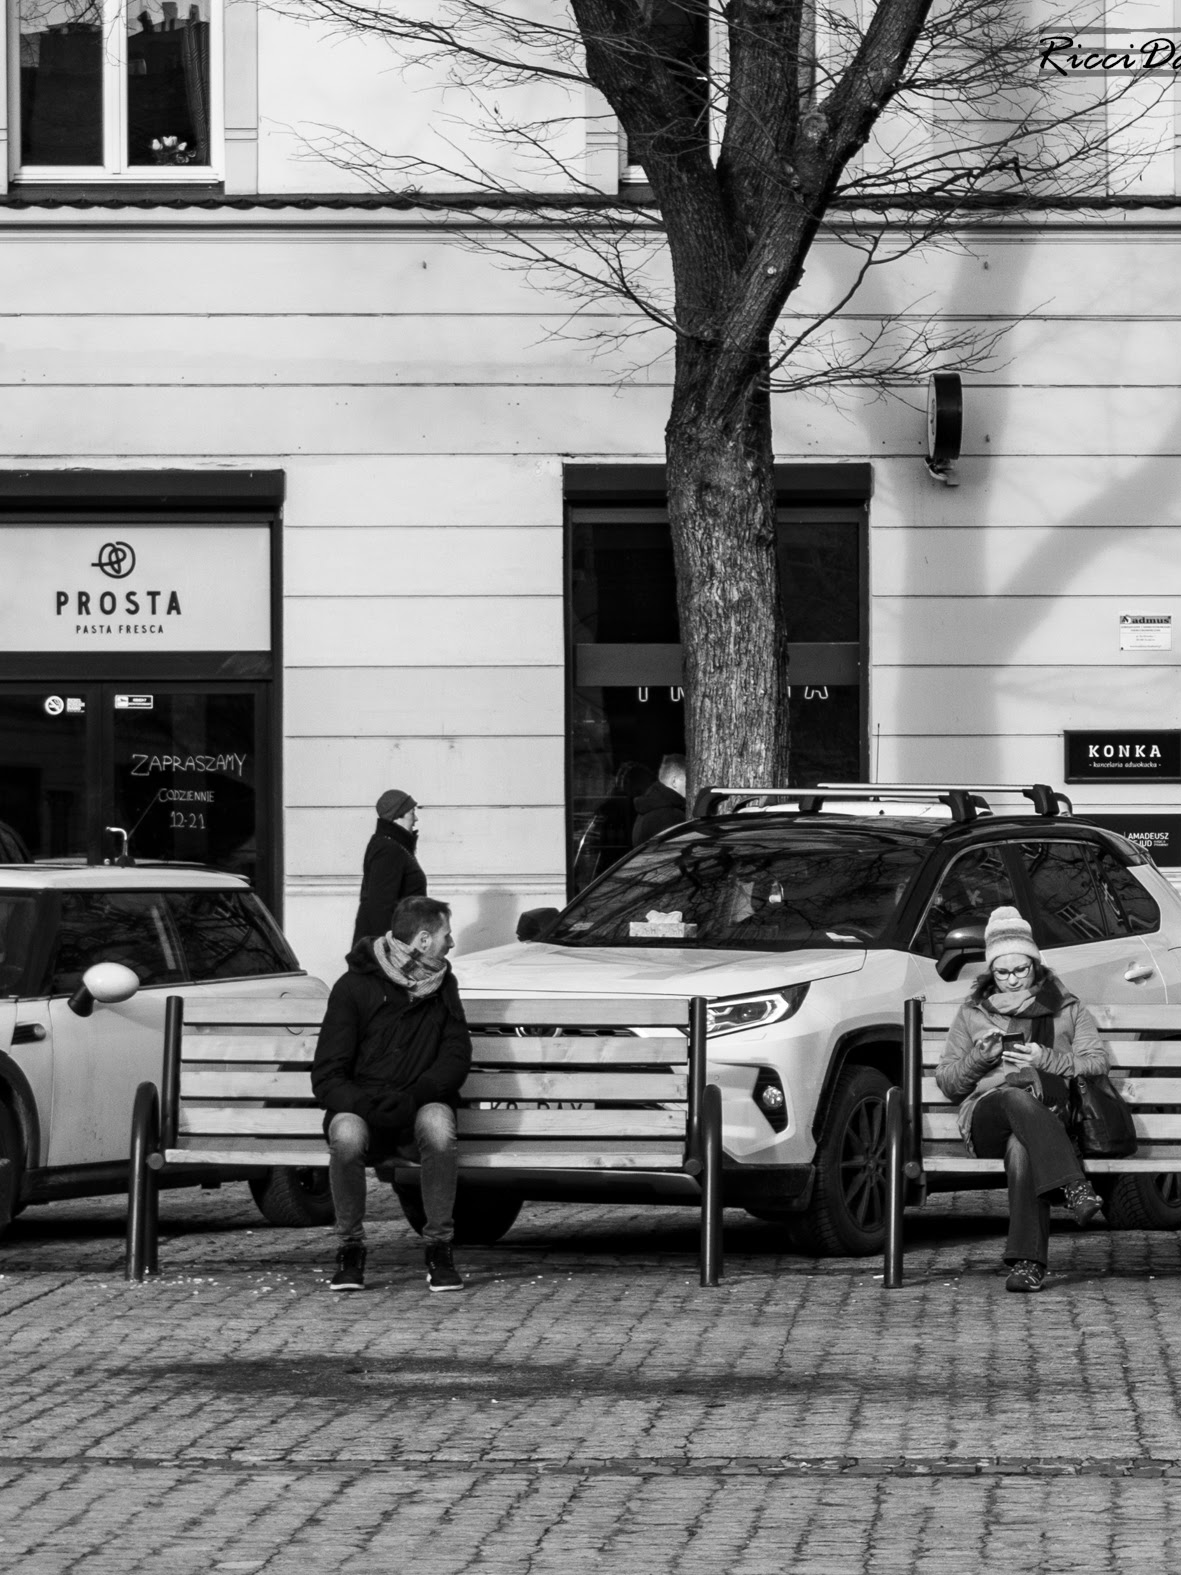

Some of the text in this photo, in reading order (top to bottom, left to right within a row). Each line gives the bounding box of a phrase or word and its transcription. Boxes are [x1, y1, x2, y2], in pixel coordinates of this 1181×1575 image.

[56, 590, 182, 616] PROSTA
[76, 624, 164, 634] PASTA FRESCA
[1088, 744, 1162, 758] KONKA
[130, 753, 247, 777] ZAPRASZAMY
[158, 788, 215, 803] CODZIENNIE
[1128, 832, 1169, 840] AMADEUSZ
